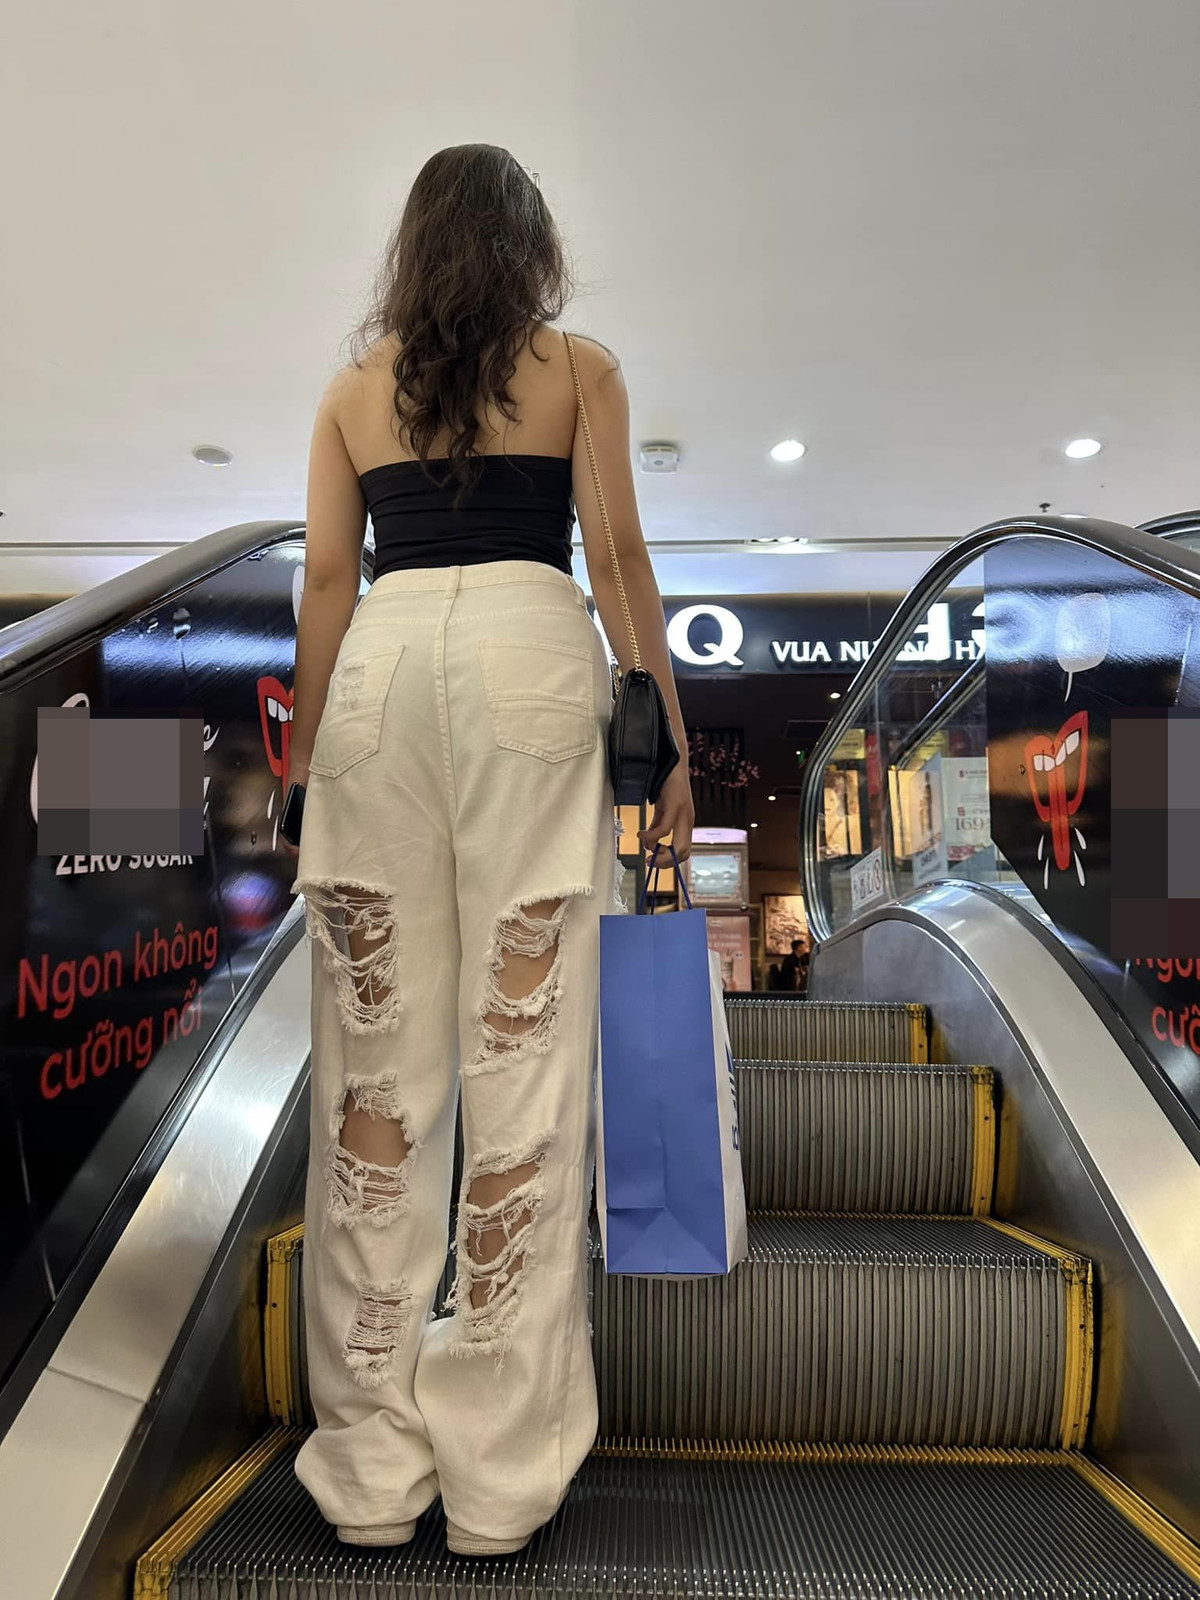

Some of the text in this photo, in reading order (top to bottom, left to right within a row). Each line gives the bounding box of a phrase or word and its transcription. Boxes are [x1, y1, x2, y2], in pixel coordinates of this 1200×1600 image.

[771, 641, 832, 663] VUA
[17, 921, 218, 1019] Ngon không
[39, 977, 203, 1100] cưỡng nổi
